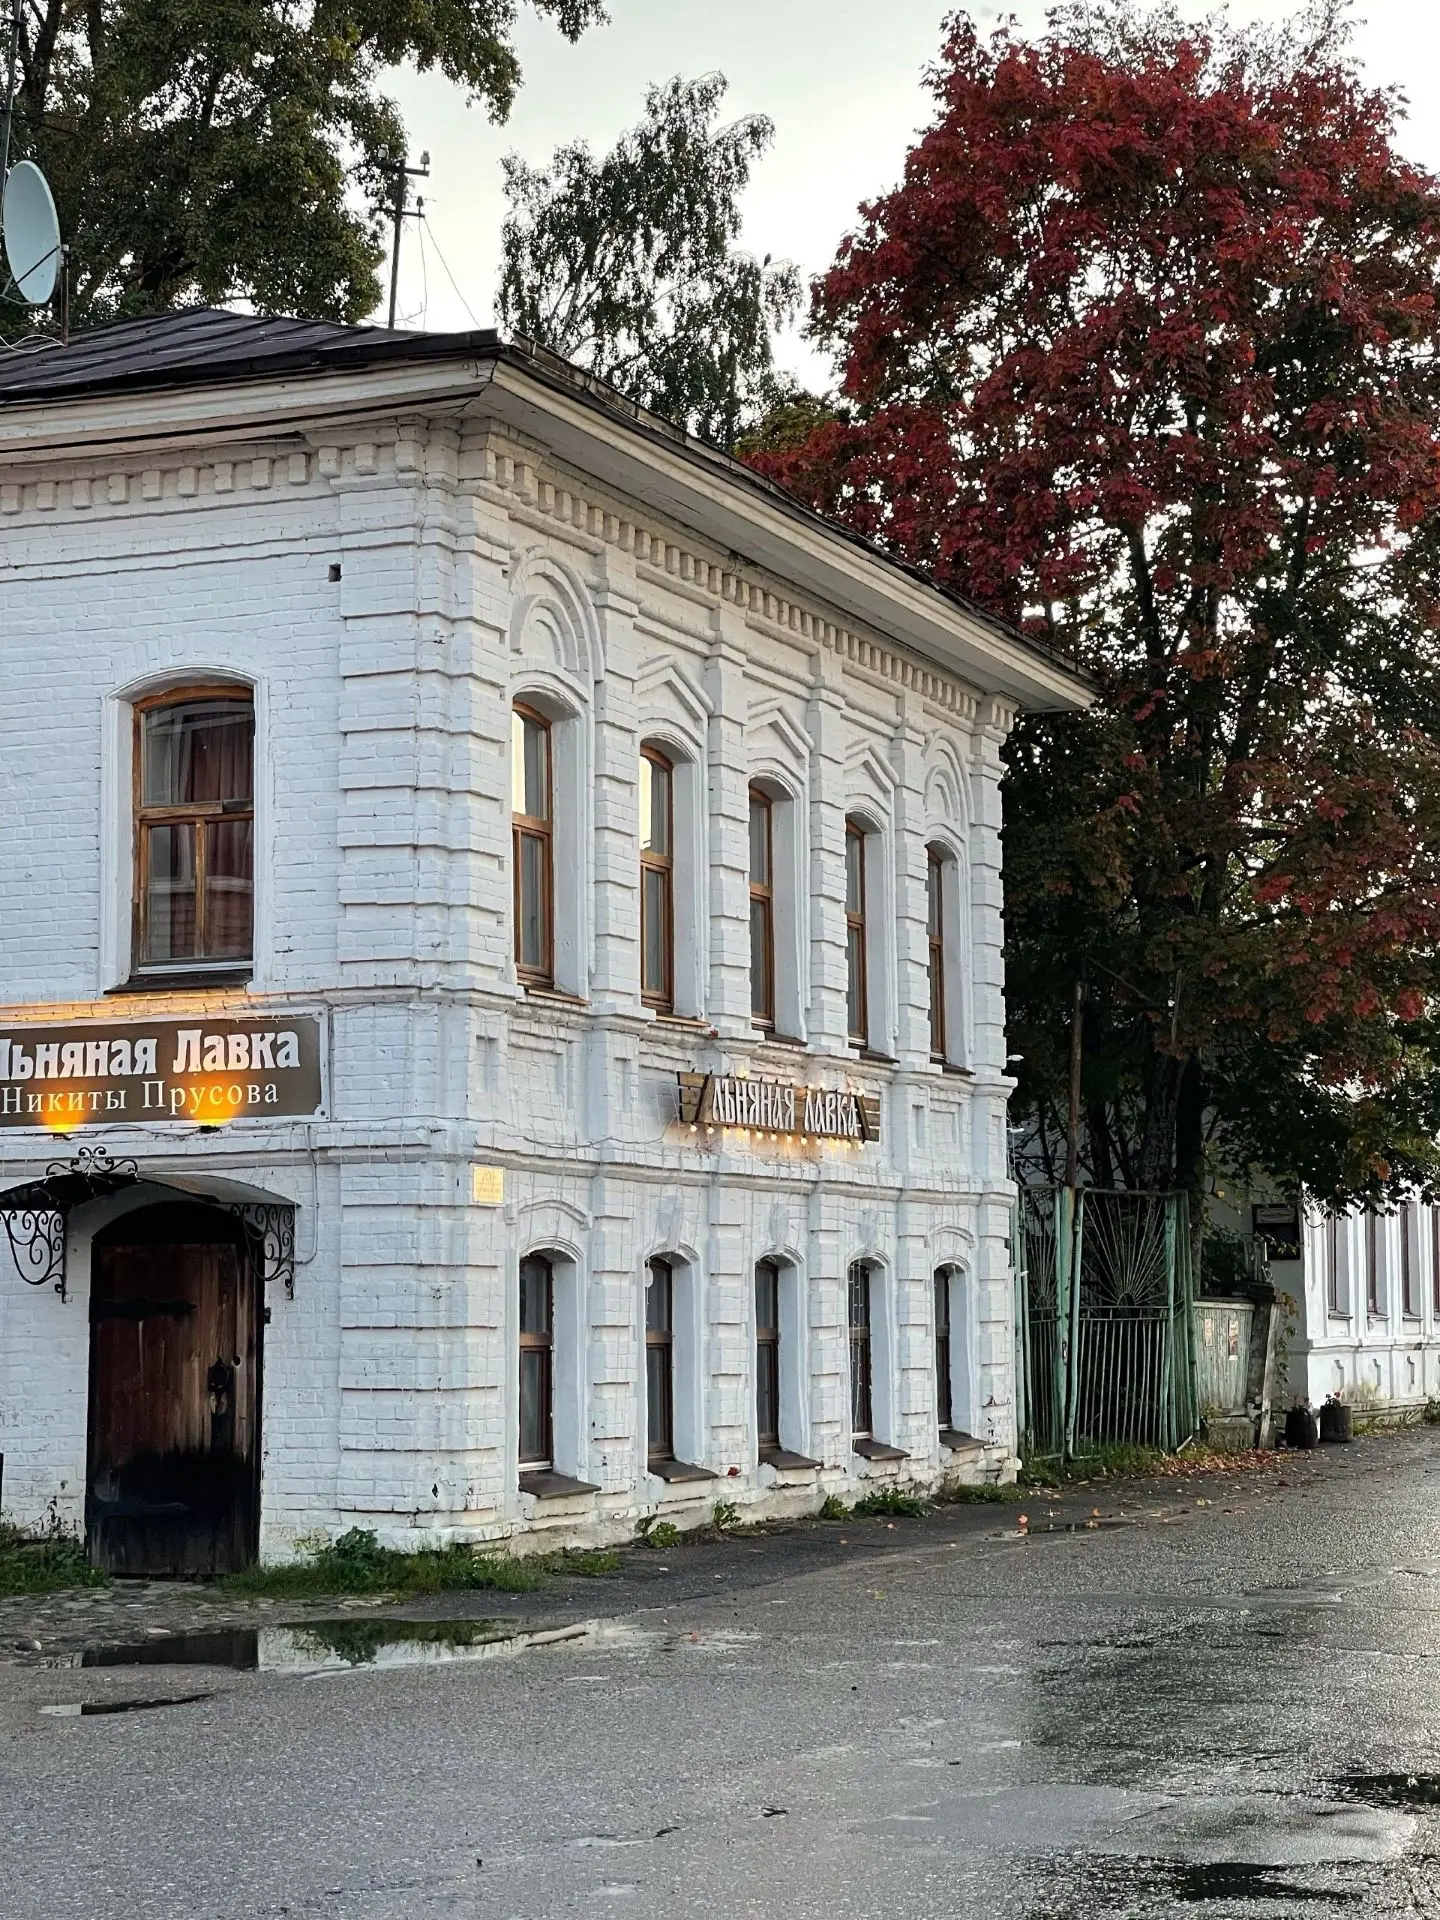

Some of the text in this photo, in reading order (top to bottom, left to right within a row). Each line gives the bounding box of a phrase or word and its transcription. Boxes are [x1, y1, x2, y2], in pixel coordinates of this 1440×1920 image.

[173, 1030, 300, 1074] Лавка
[1, 1080, 279, 1115] Никиты Прусова
